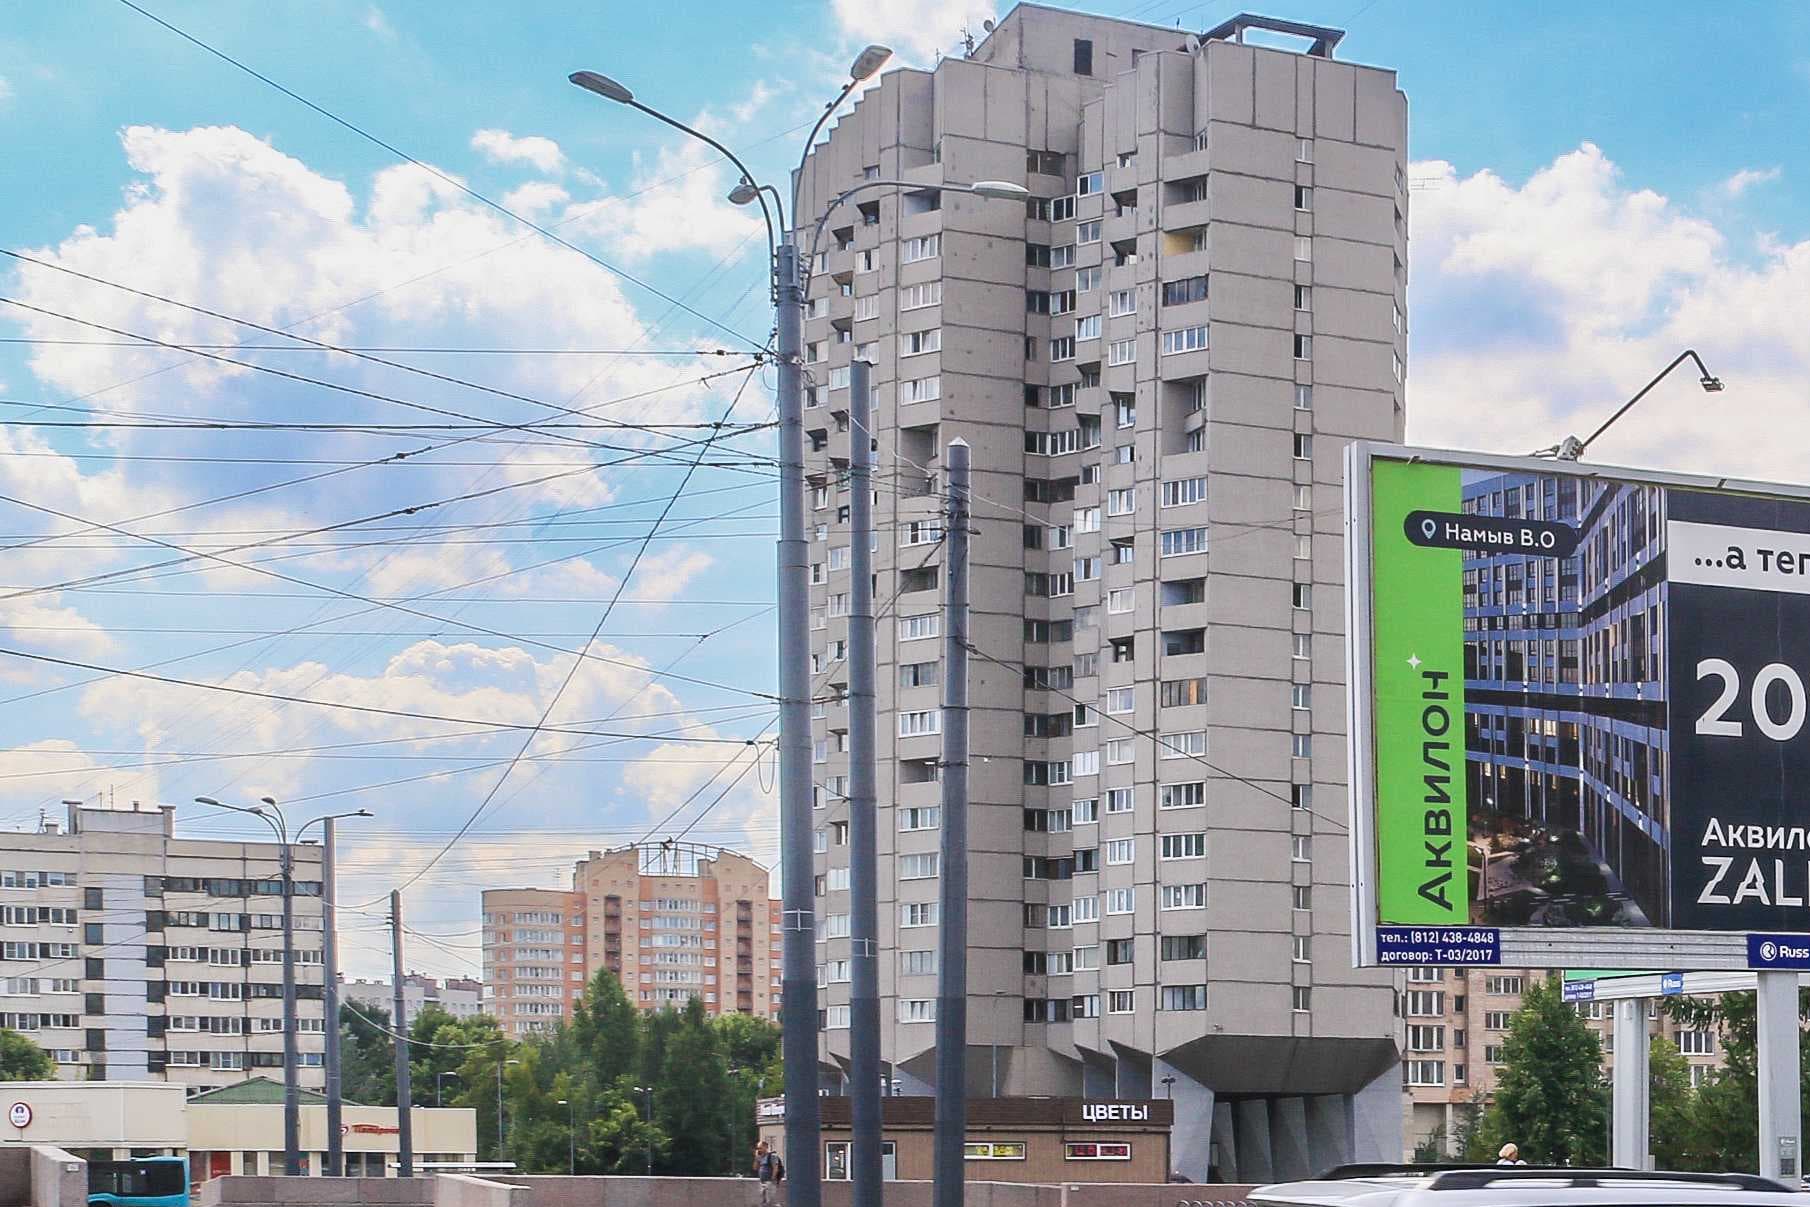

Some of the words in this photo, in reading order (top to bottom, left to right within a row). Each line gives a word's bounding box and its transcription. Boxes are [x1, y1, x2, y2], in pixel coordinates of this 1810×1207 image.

[1445, 522, 1514, 545] Намыв
[1520, 529, 1555, 549] В.О
[1380, 932, 1408, 944] тел.:
[1411, 931, 1439, 944] (812)
[1442, 931, 1494, 944] 438-4848
[1381, 951, 1433, 963] договор:
[1779, 946, 1810, 959] Russ
[1082, 1104, 1148, 1122] ЦВЕТЫ
